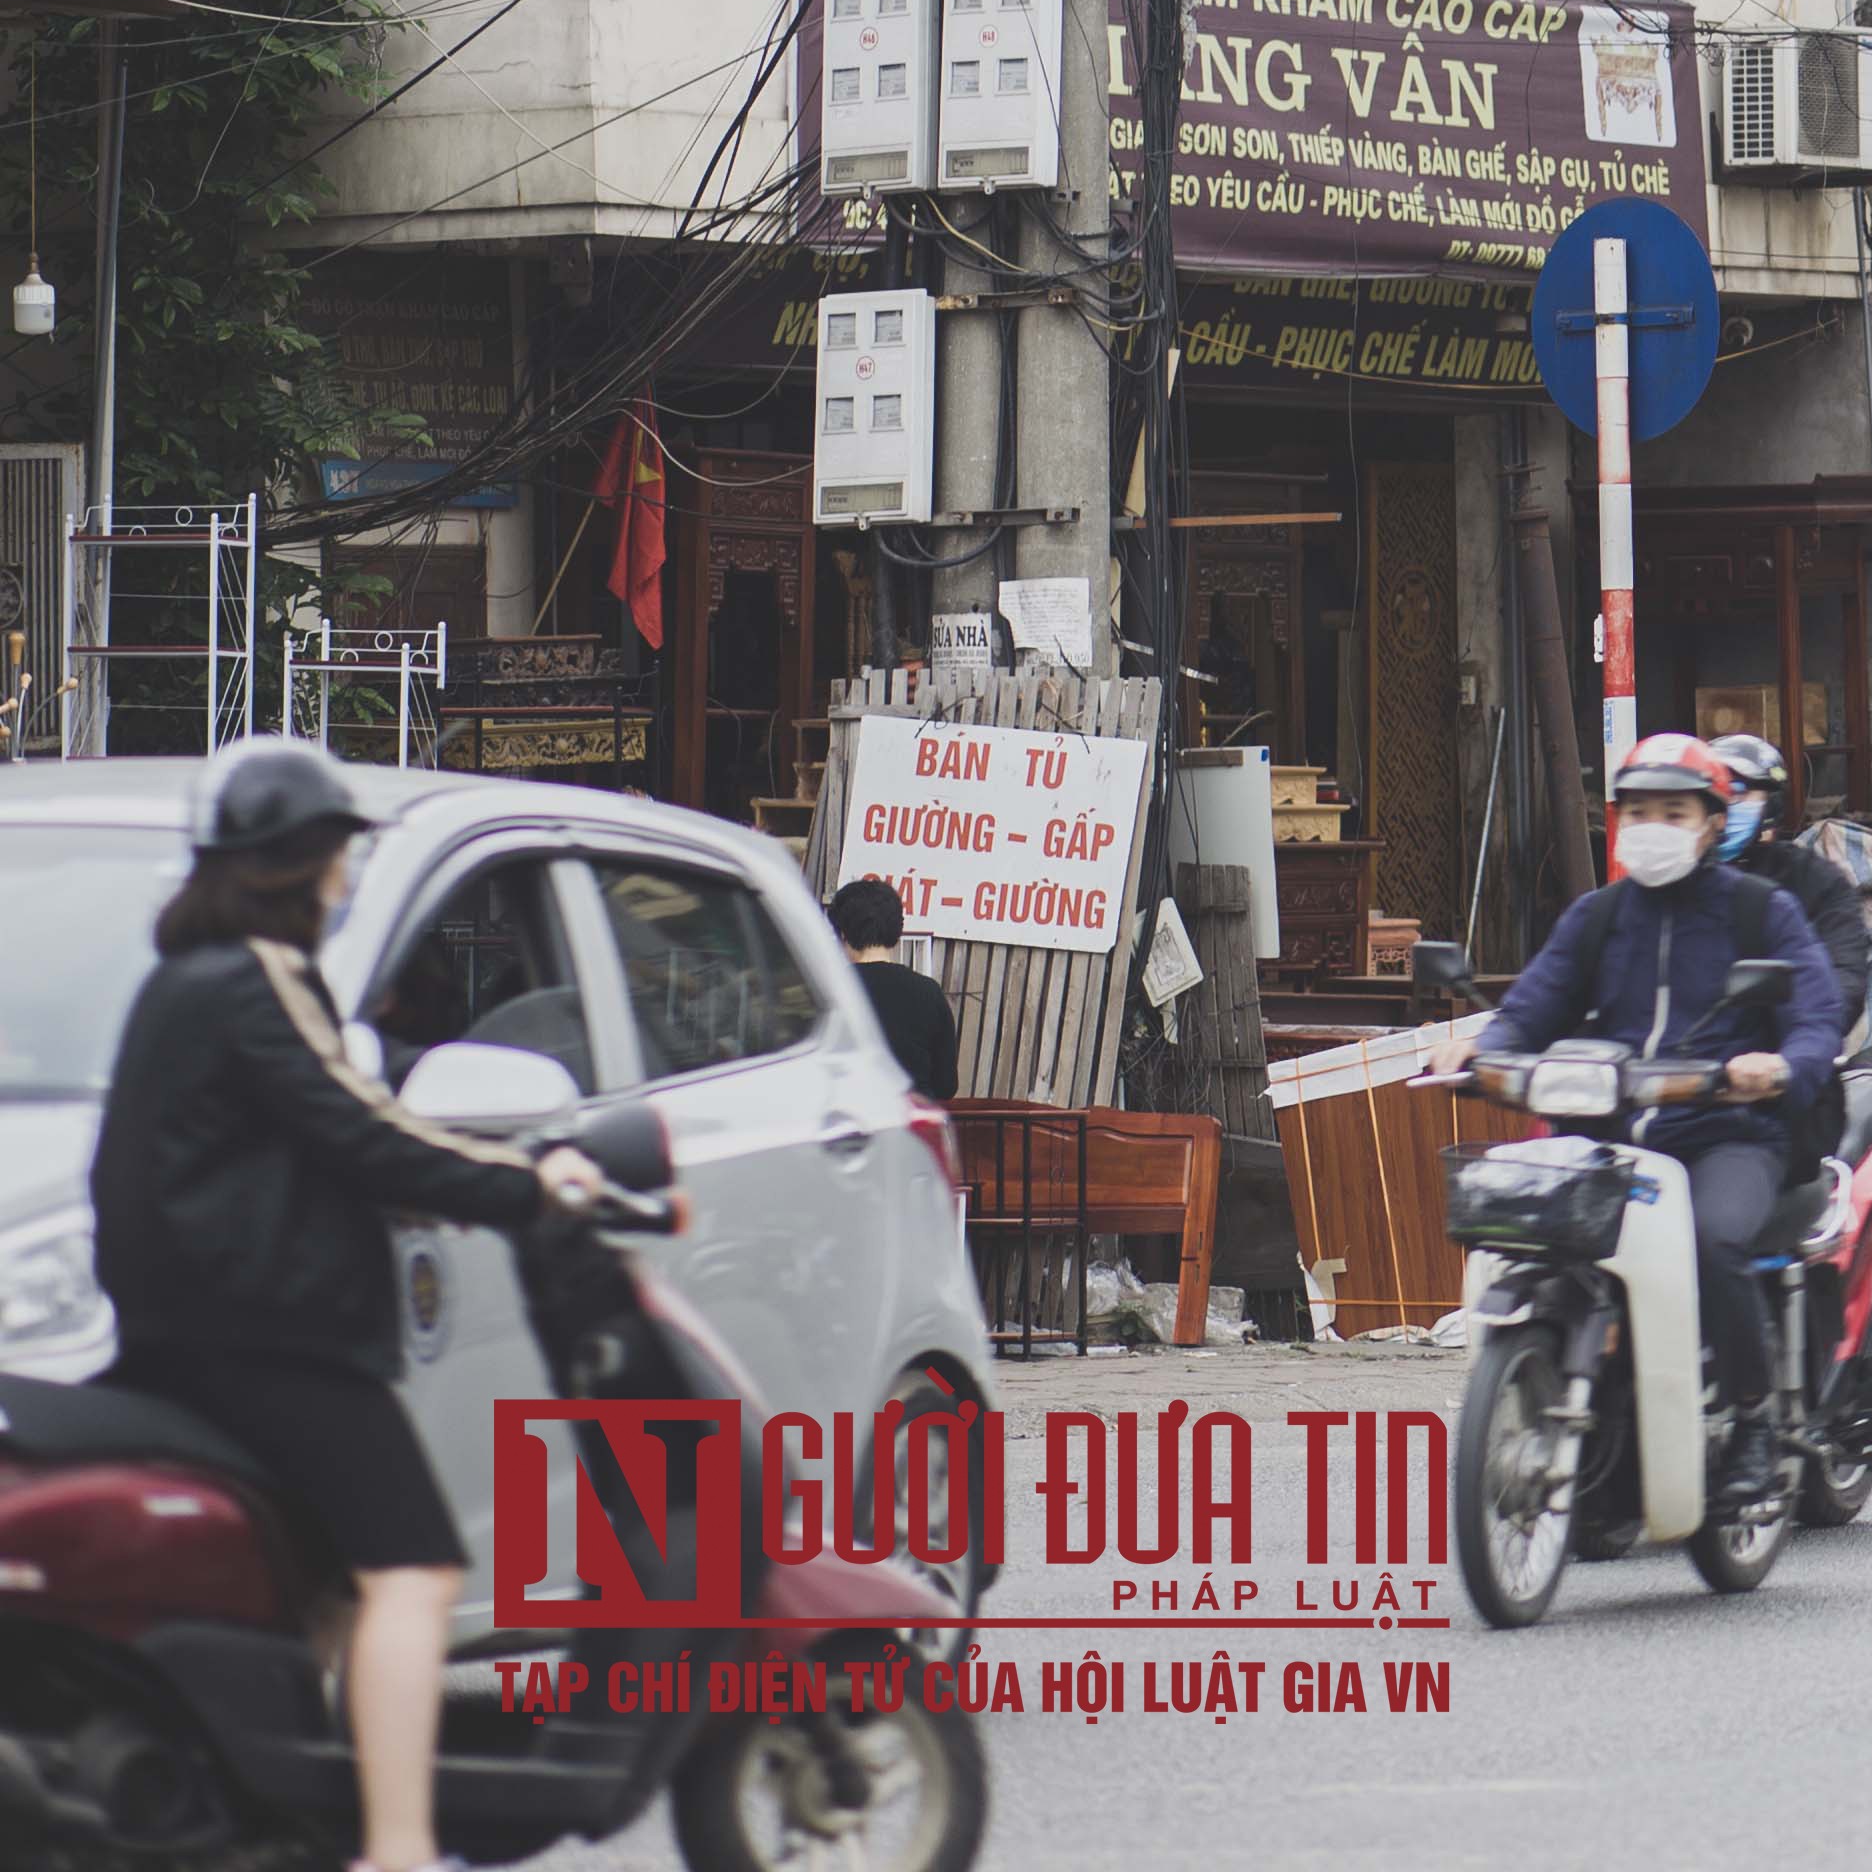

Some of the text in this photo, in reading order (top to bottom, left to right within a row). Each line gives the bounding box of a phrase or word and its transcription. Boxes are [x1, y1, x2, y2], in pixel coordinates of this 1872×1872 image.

[1331, 32, 1499, 130] VÂN
[1179, 122, 1227, 157] SƠN
[1232, 128, 1285, 165] SON,
[1288, 124, 1344, 166] THIẾP
[1350, 132, 1413, 178] VÀNG,
[1419, 136, 1462, 179] BÀN
[1465, 140, 1512, 187] GHẾ,
[1516, 146, 1556, 194] SẬP
[1599, 150, 1627, 192] TỦ
[1630, 152, 1672, 196] CHÈ
[1206, 172, 1252, 209] YÊU
[1256, 170, 1305, 215] CẦU
[1323, 184, 1382, 225] PHỤC
[1387, 184, 1434, 228] CHẾ,
[1440, 188, 1480, 229] LÀM
[1525, 189, 1556, 234] ĐỒ
[1273, 327, 1357, 382] PHỤC
[1423, 322, 1489, 381] LÀM
[956, 619, 989, 648] NHÀ
[915, 732, 1068, 789] BÁN TỦ
[863, 800, 996, 853] GIƯỜNG
[1043, 807, 1116, 862] GẤP
[973, 878, 1107, 930] GIƯỜNG
